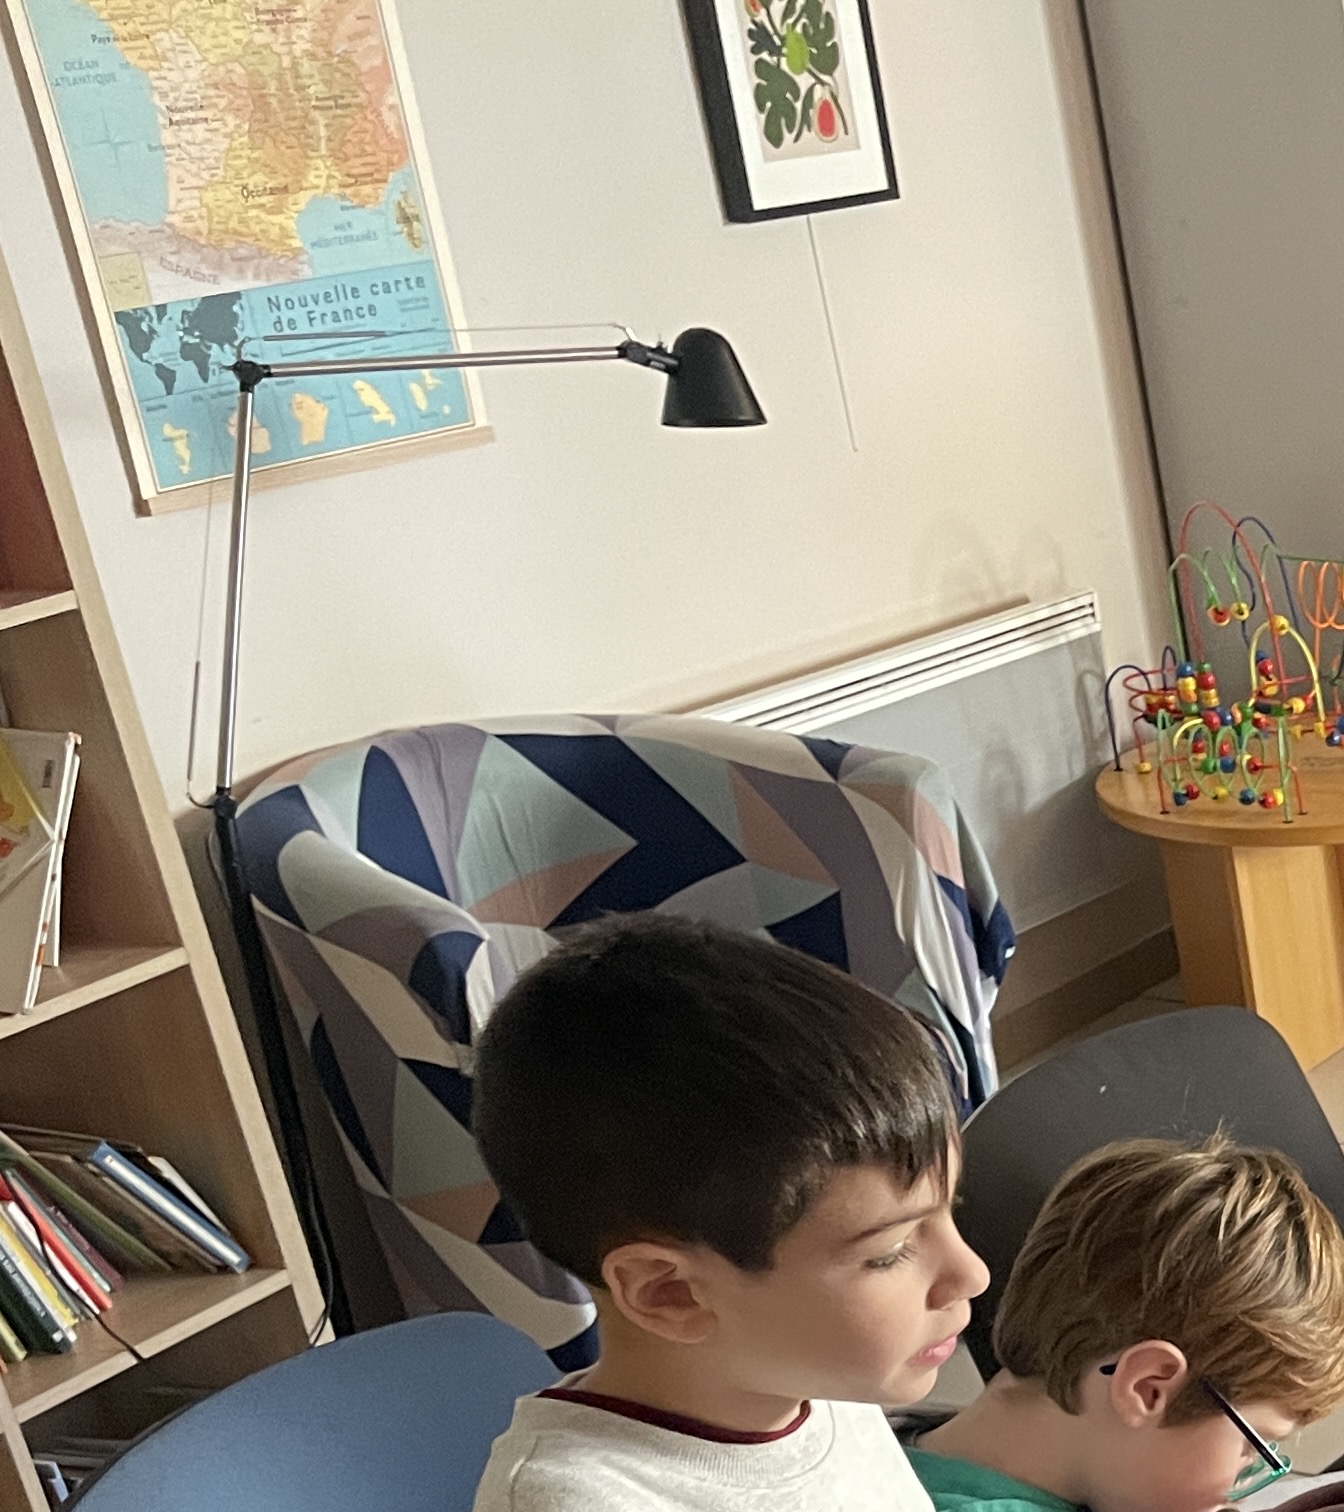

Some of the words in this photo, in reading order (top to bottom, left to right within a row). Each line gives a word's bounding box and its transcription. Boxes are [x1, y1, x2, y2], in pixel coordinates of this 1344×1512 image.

[267, 283, 361, 314] Nouvelle
[370, 276, 427, 297] carte
[273, 315, 298, 333] de
[307, 303, 378, 328] France
